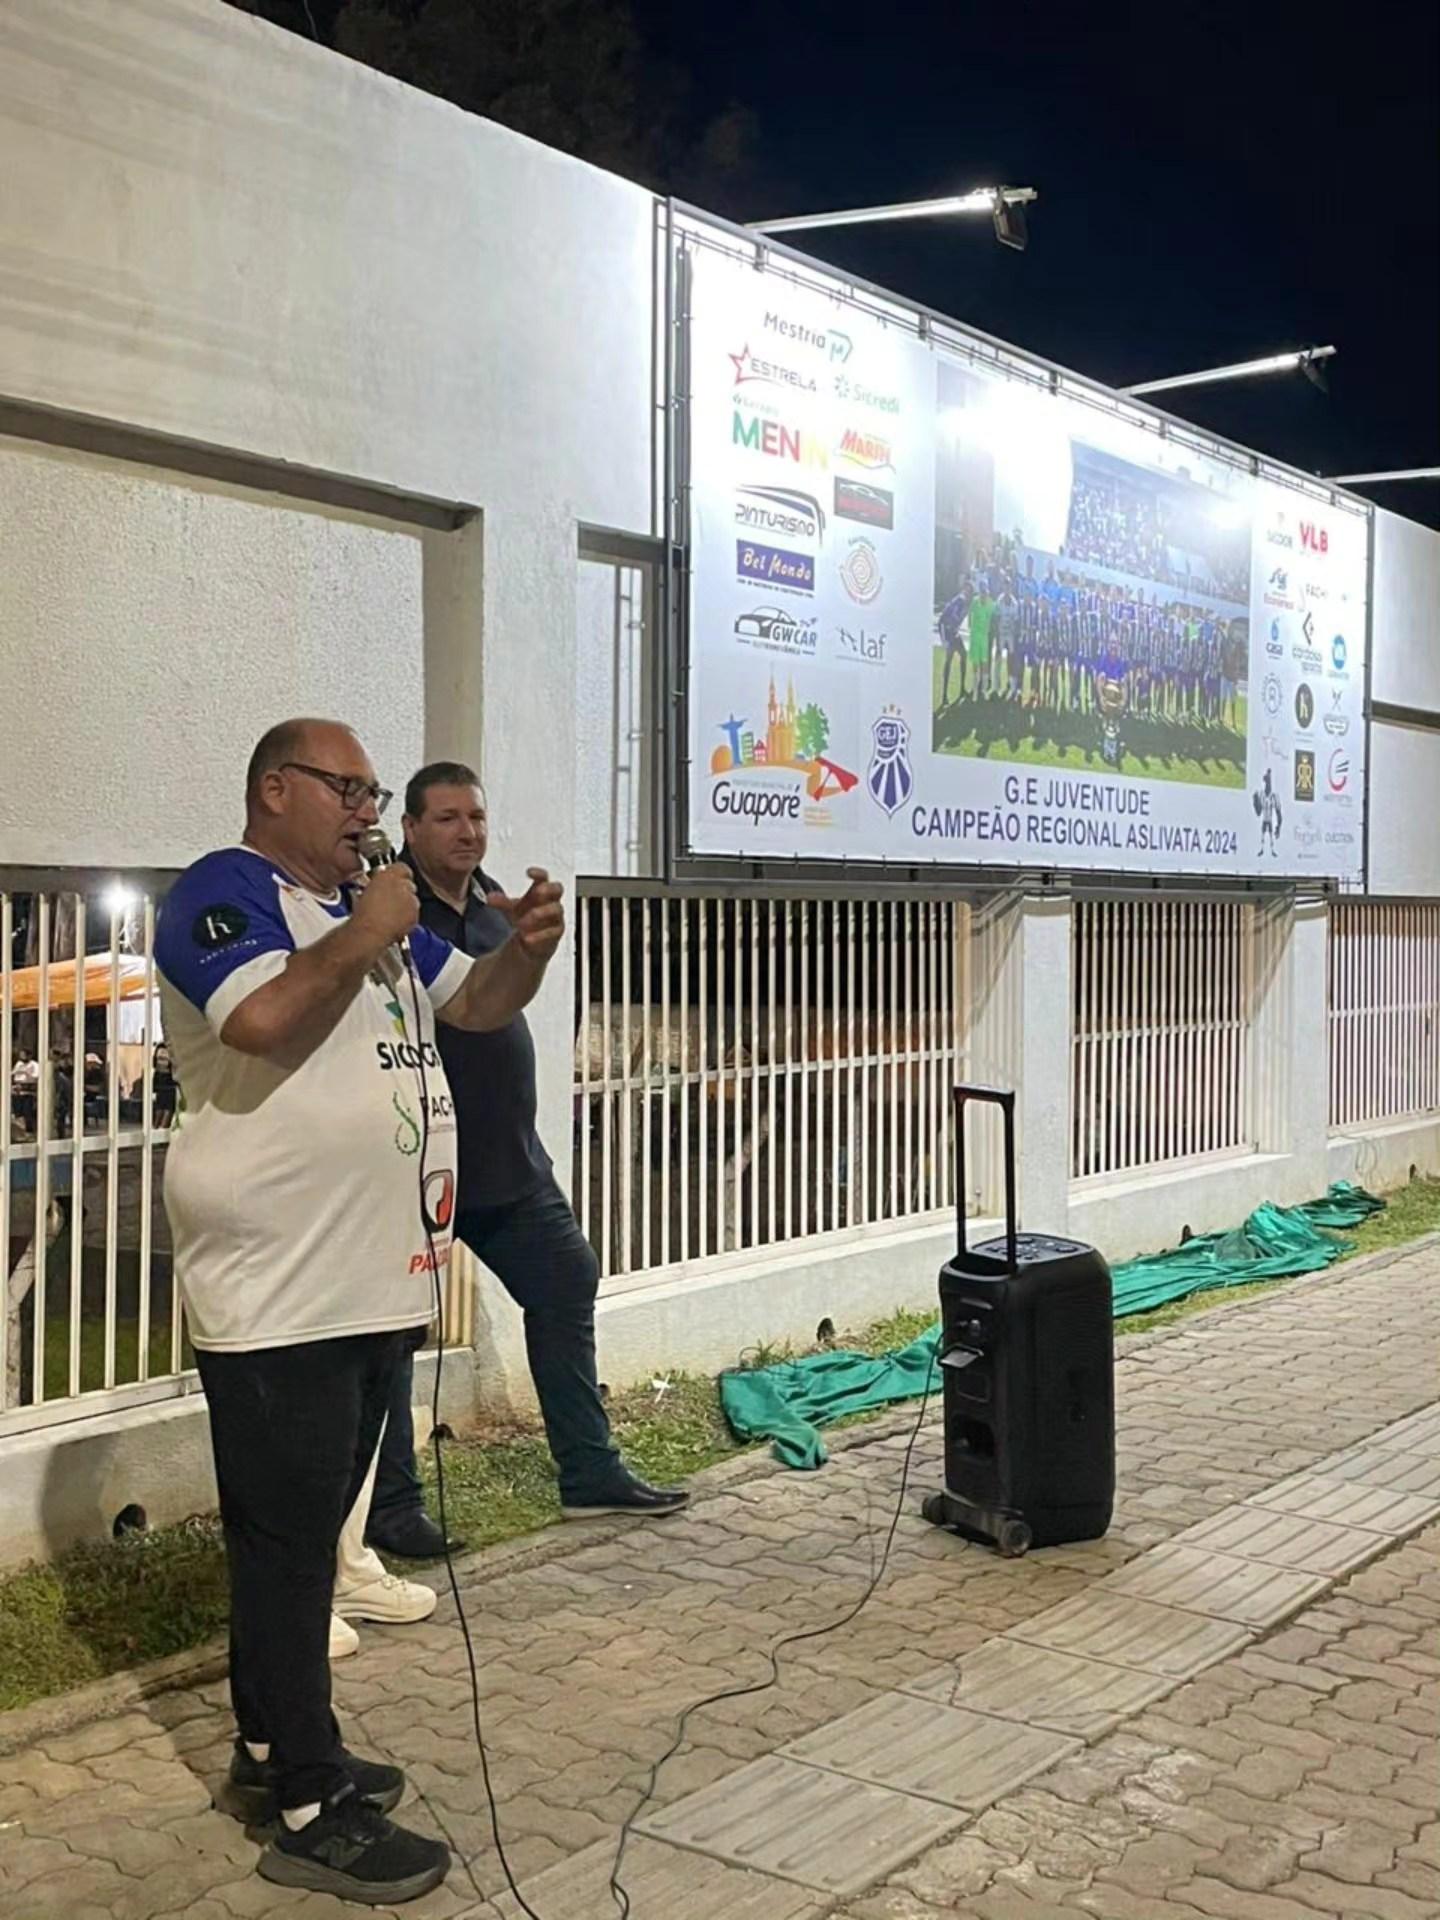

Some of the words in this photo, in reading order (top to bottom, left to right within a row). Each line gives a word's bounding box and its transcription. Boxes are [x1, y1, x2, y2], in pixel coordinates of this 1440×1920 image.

[763, 310, 826, 349] Mestria
[750, 358, 817, 392] ESTRELA
[853, 383, 900, 415] Sicredi
[1299, 519, 1329, 554] VLB
[743, 547, 766, 571] Bel
[768, 553, 812, 582] Mondo
[771, 624, 817, 648] GWCAR
[860, 629, 888, 660] laf
[712, 781, 801, 827] Guaporé
[1004, 774, 1038, 806] G.E
[1044, 780, 1151, 816] JUVENTUDE
[911, 805, 1021, 842] CAMPEÃO
[1027, 815, 1122, 849] REGIONAL
[1126, 823, 1202, 853] ASLIVATA
[1204, 830, 1239, 856] 2024
